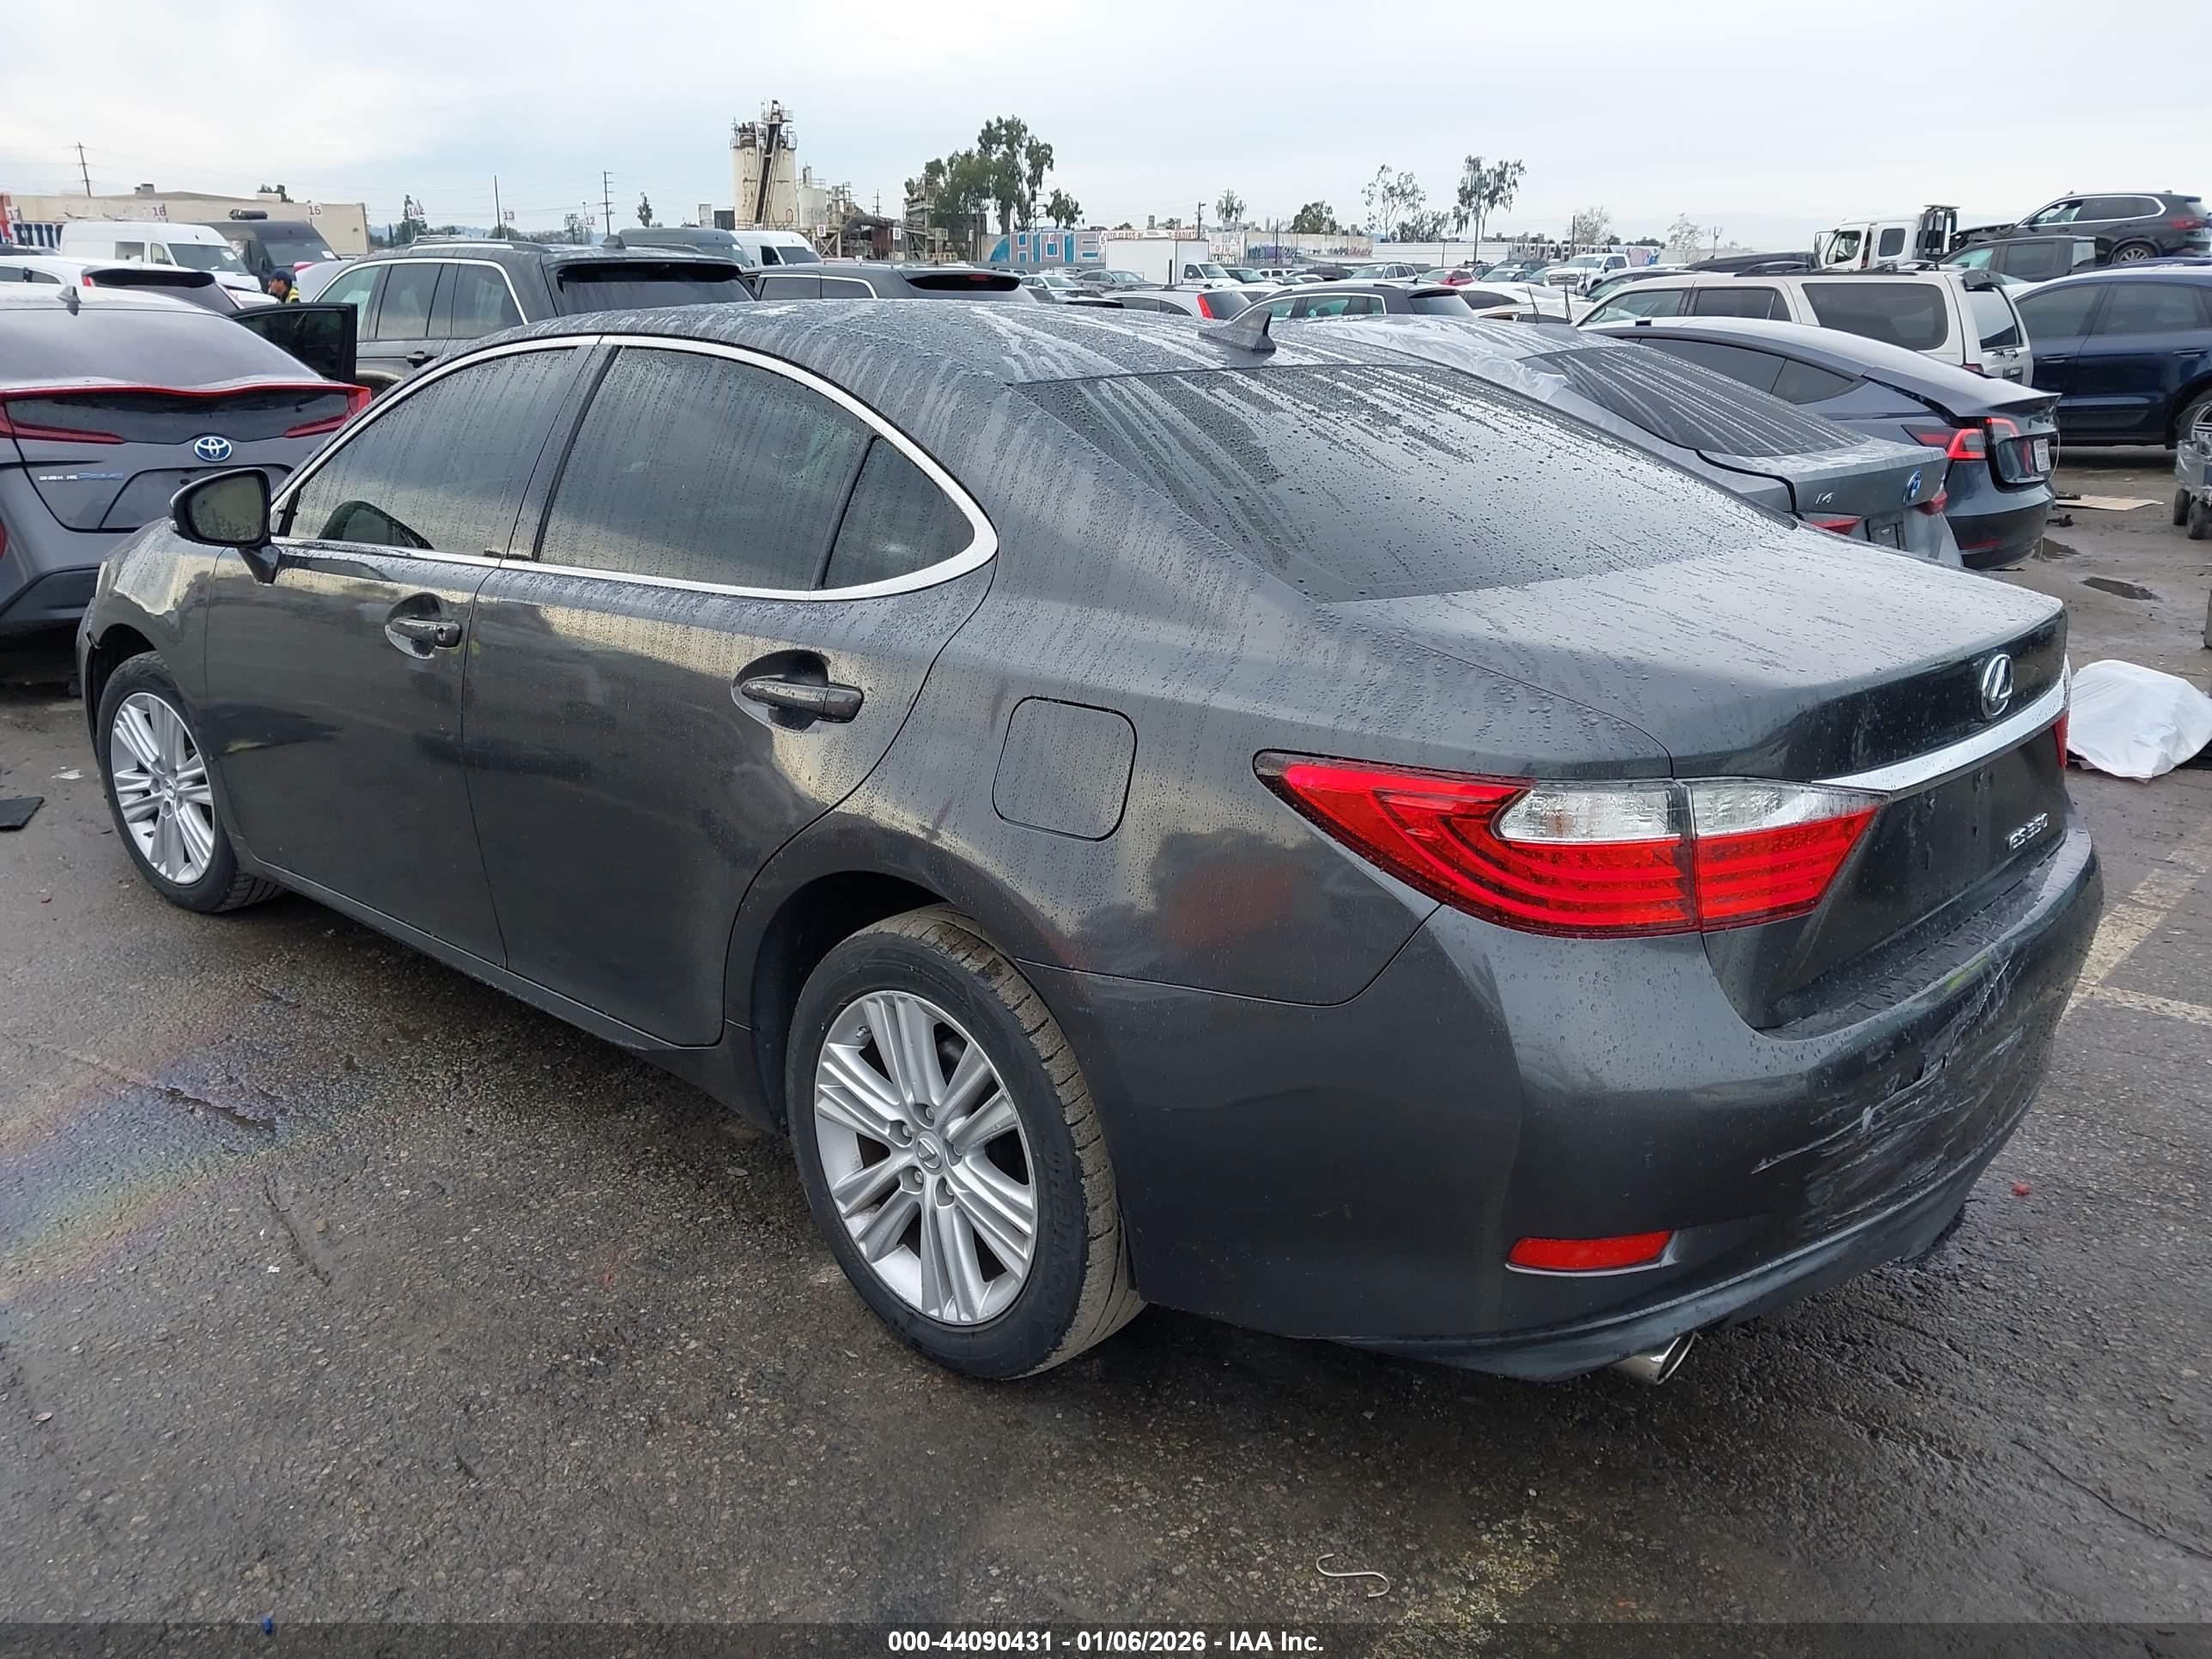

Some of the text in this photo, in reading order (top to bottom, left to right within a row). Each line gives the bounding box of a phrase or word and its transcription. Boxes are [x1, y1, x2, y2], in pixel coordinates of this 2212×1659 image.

[309, 205, 321, 215] 15
[503, 211, 514, 220] 13
[586, 216, 595, 225] 12
